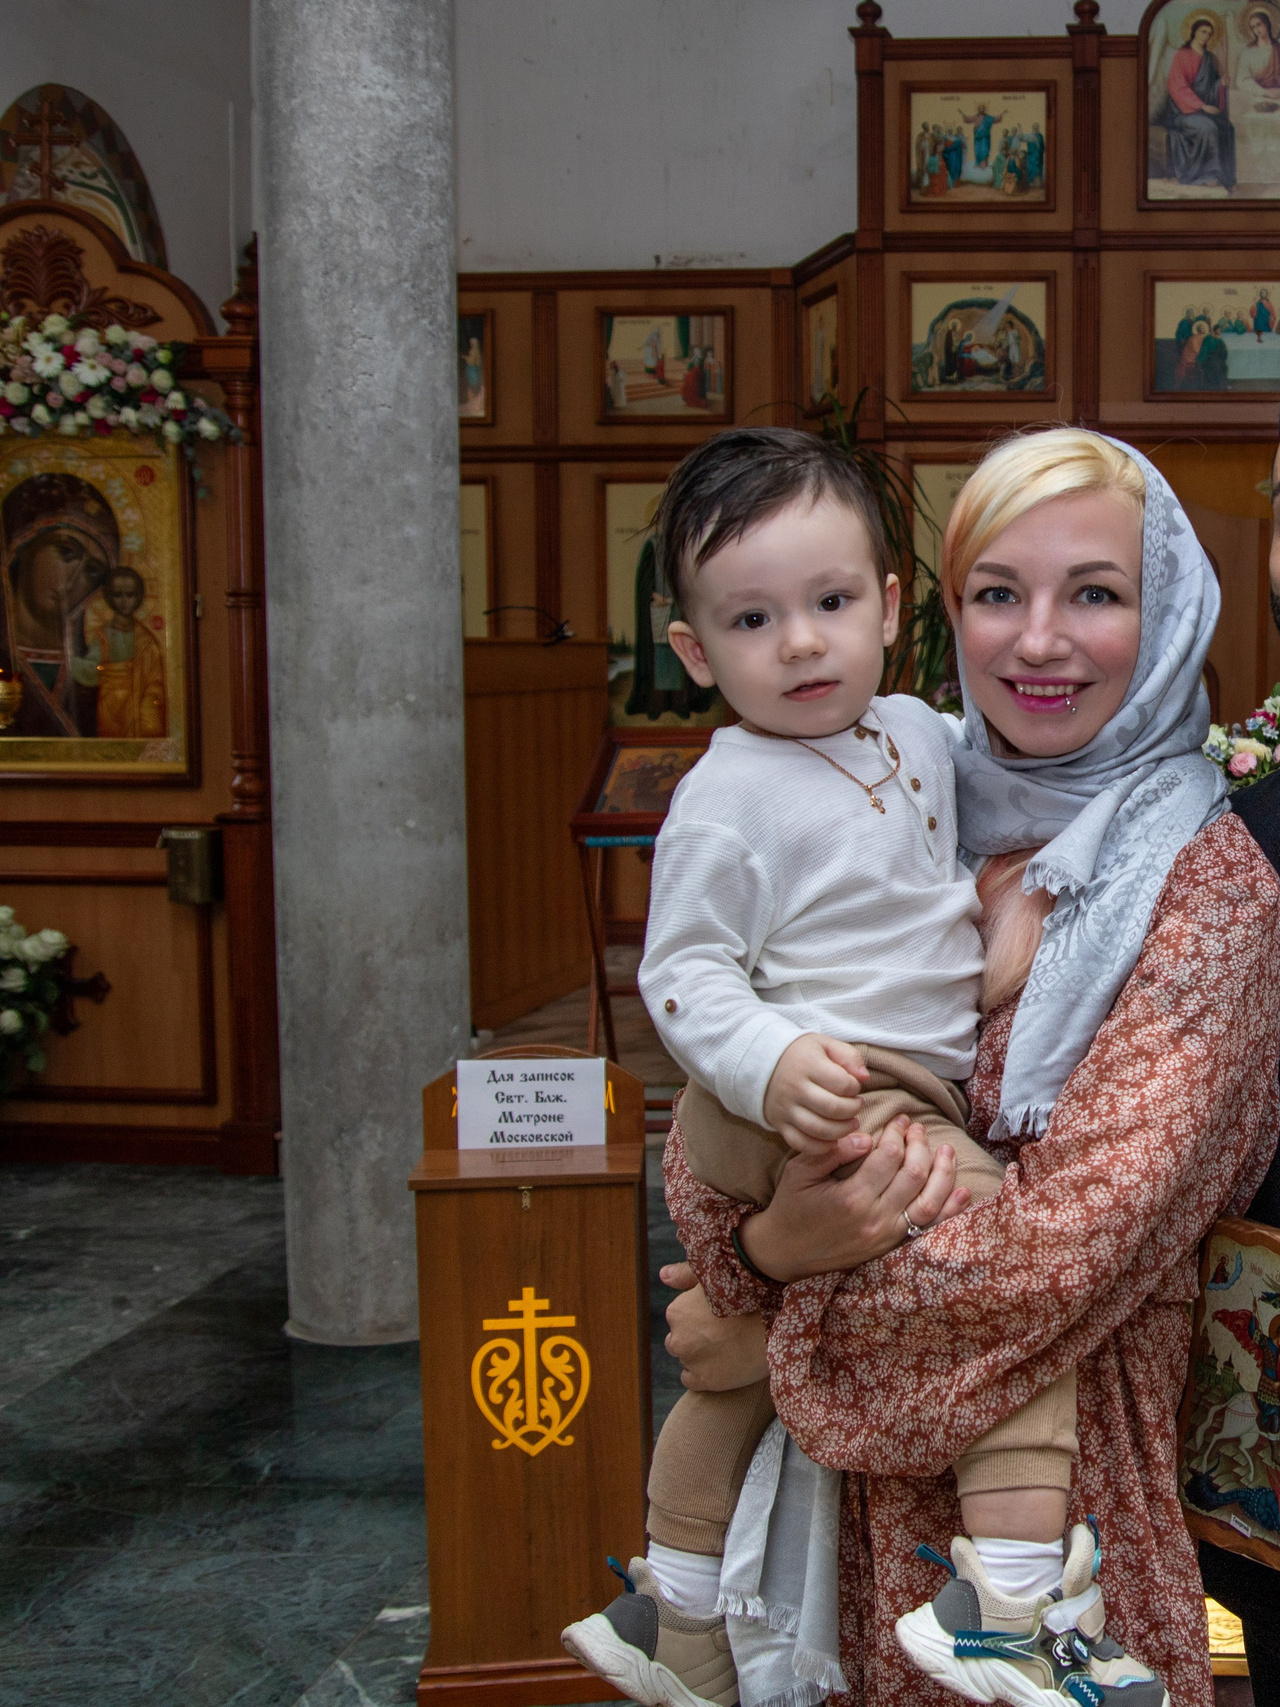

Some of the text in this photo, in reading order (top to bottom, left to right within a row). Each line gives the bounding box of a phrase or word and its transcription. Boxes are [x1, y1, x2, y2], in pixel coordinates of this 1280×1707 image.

[486, 1070, 575, 1085] Для записок
[494, 1090, 567, 1105] Свт. Блж.
[497, 1111, 565, 1126] Матроне
[489, 1131, 574, 1144] Московской
